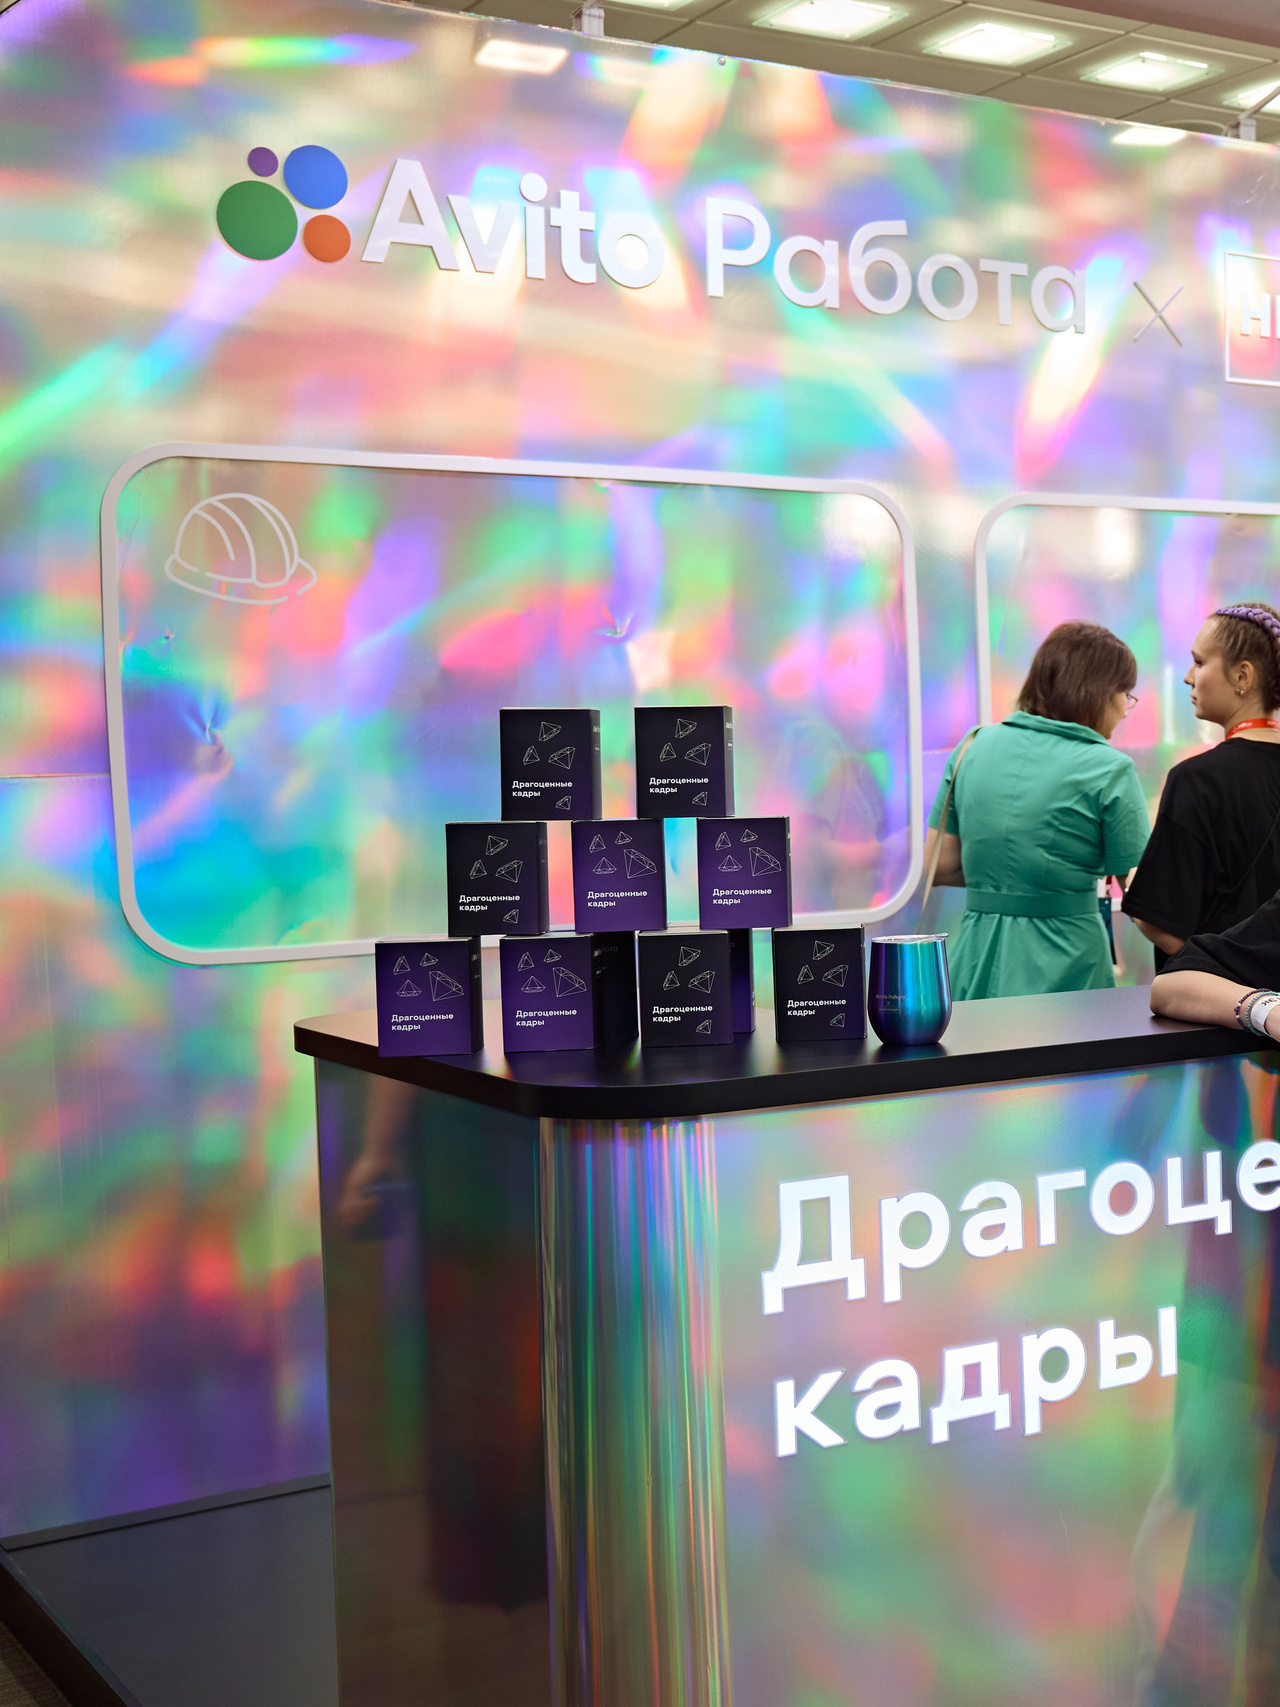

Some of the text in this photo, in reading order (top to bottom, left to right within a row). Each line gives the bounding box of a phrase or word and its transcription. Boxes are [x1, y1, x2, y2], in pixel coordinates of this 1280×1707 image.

[360, 158, 664, 289] Avito
[706, 197, 1087, 334] Работа
[512, 780, 573, 789] Драгоценные
[649, 776, 709, 785] Драгоценные
[587, 891, 648, 899] Драгоценные
[712, 888, 772, 897] Драгоценные
[459, 894, 521, 903] Драгоценные
[587, 900, 616, 908] кадры
[786, 999, 847, 1008] Драгоценные
[515, 1009, 577, 1018] Драгоценные
[652, 1005, 713, 1014] Драгоценные
[391, 1013, 454, 1023] Драгоценные
[515, 1019, 545, 1027] кадры
[391, 1024, 421, 1032] кадры
[774, 1305, 1179, 1459] кадры
